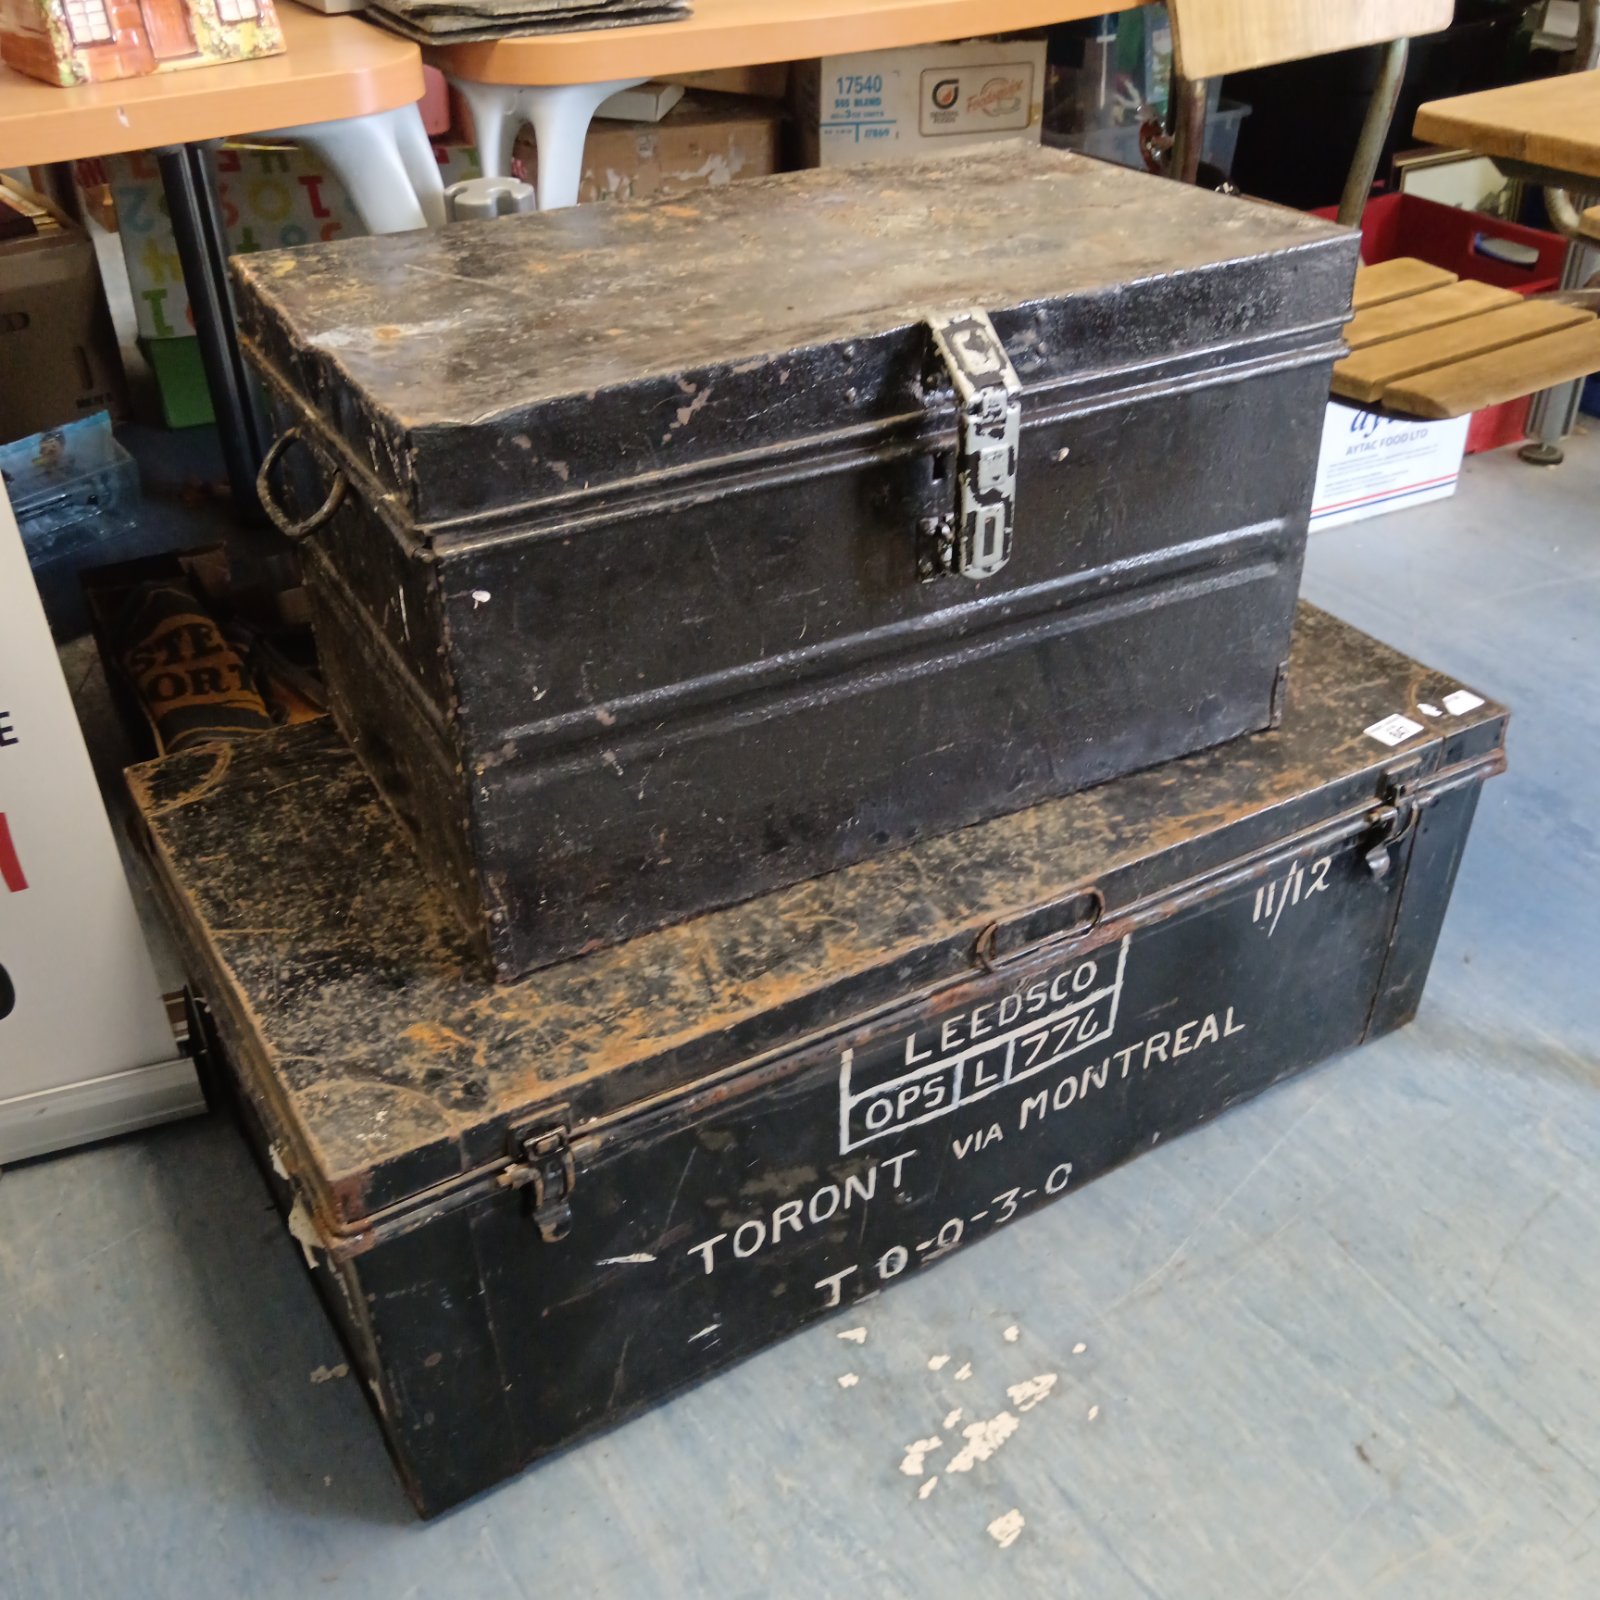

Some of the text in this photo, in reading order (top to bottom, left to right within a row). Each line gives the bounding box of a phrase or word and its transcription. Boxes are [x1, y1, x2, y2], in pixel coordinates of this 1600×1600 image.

[836, 75, 883, 95] 17540
[1345, 428, 1429, 456] AYTAC FOOD LTD
[1252, 856, 1332, 938] 11/12
[904, 960, 1098, 1066] LEEDSCO
[865, 1075, 946, 1130] OPS
[974, 1060, 998, 1087] L
[687, 1006, 1246, 1275] TORONT VIA MONTREAL
[814, 1264, 858, 1308] T
